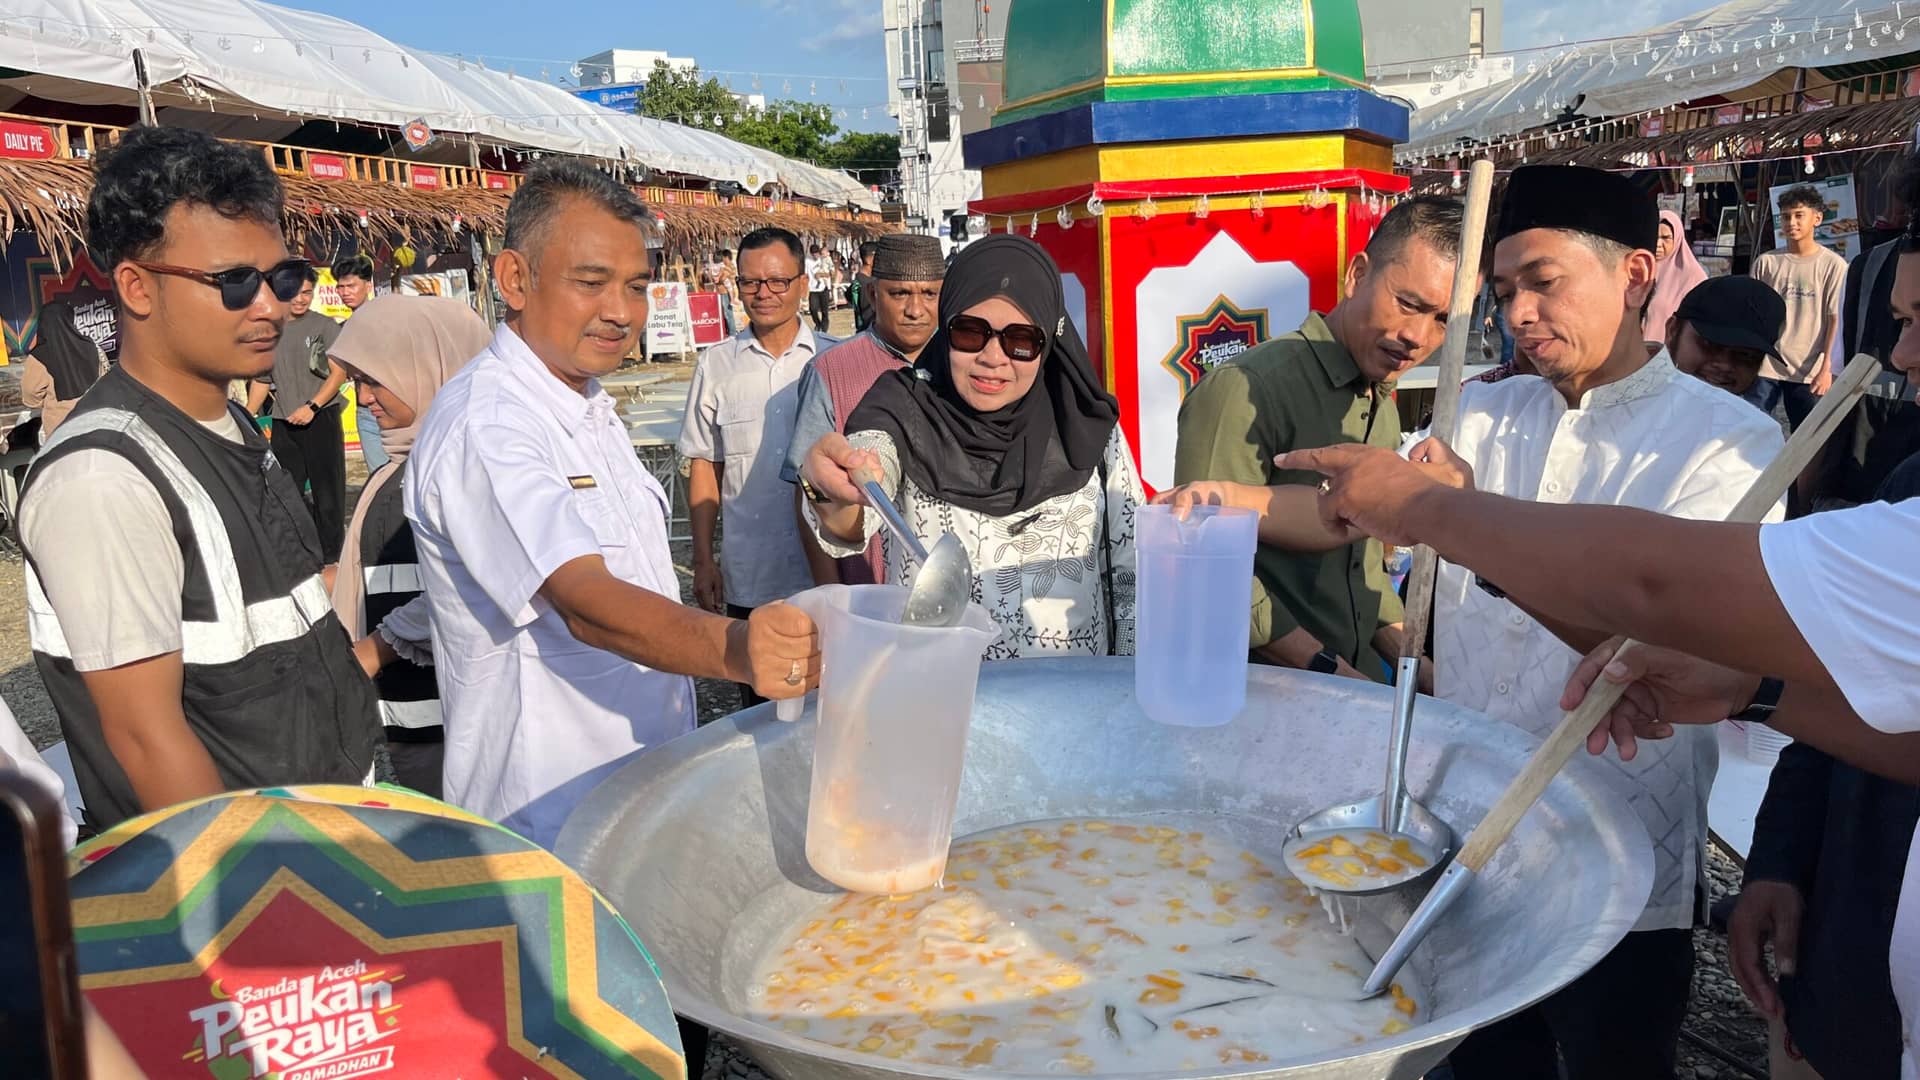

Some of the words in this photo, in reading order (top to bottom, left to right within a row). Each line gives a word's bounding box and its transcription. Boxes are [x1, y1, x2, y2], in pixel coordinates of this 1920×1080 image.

[4, 132, 28, 151] DAILY
[29, 135, 45, 153] PIE
[647, 321, 666, 329] Labu
[654, 313, 677, 321] Donat
[235, 977, 299, 1004] Banda
[318, 959, 367, 984] Aceh
[188, 976, 393, 1060] Peukan
[229, 1011, 400, 1078] Raya
